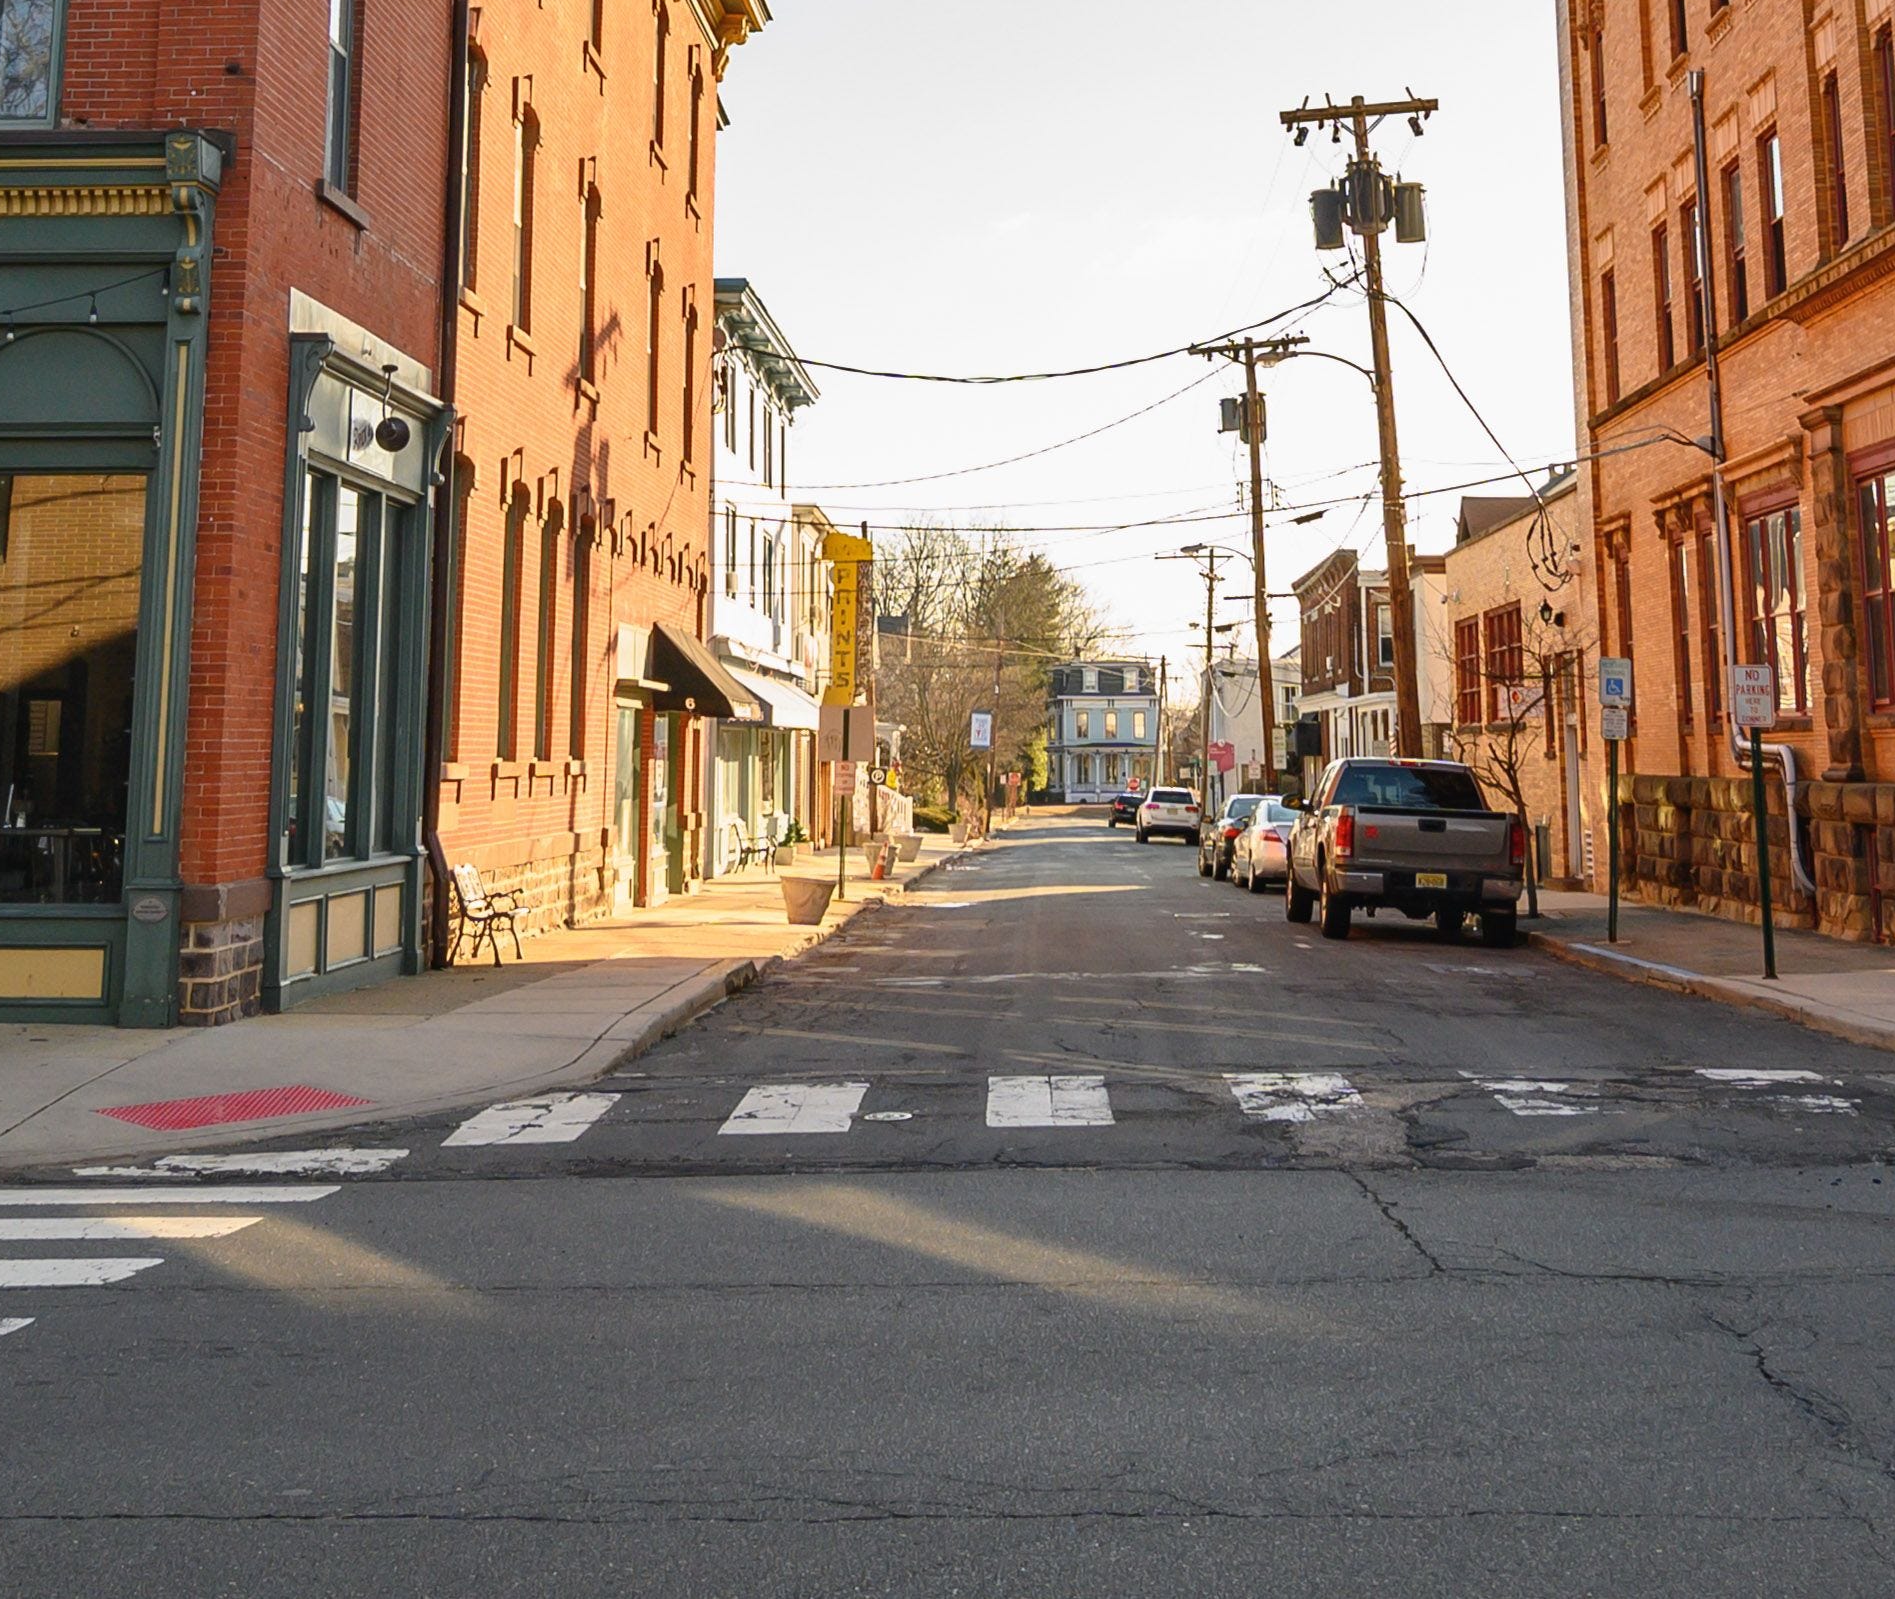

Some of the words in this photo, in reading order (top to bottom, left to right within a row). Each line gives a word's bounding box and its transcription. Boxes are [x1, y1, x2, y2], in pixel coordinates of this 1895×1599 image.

[835, 568, 851, 688] PAINTS
[1745, 670, 1760, 681] NO
[1736, 684, 1770, 695] PARKING
[685, 697, 696, 710] 6
